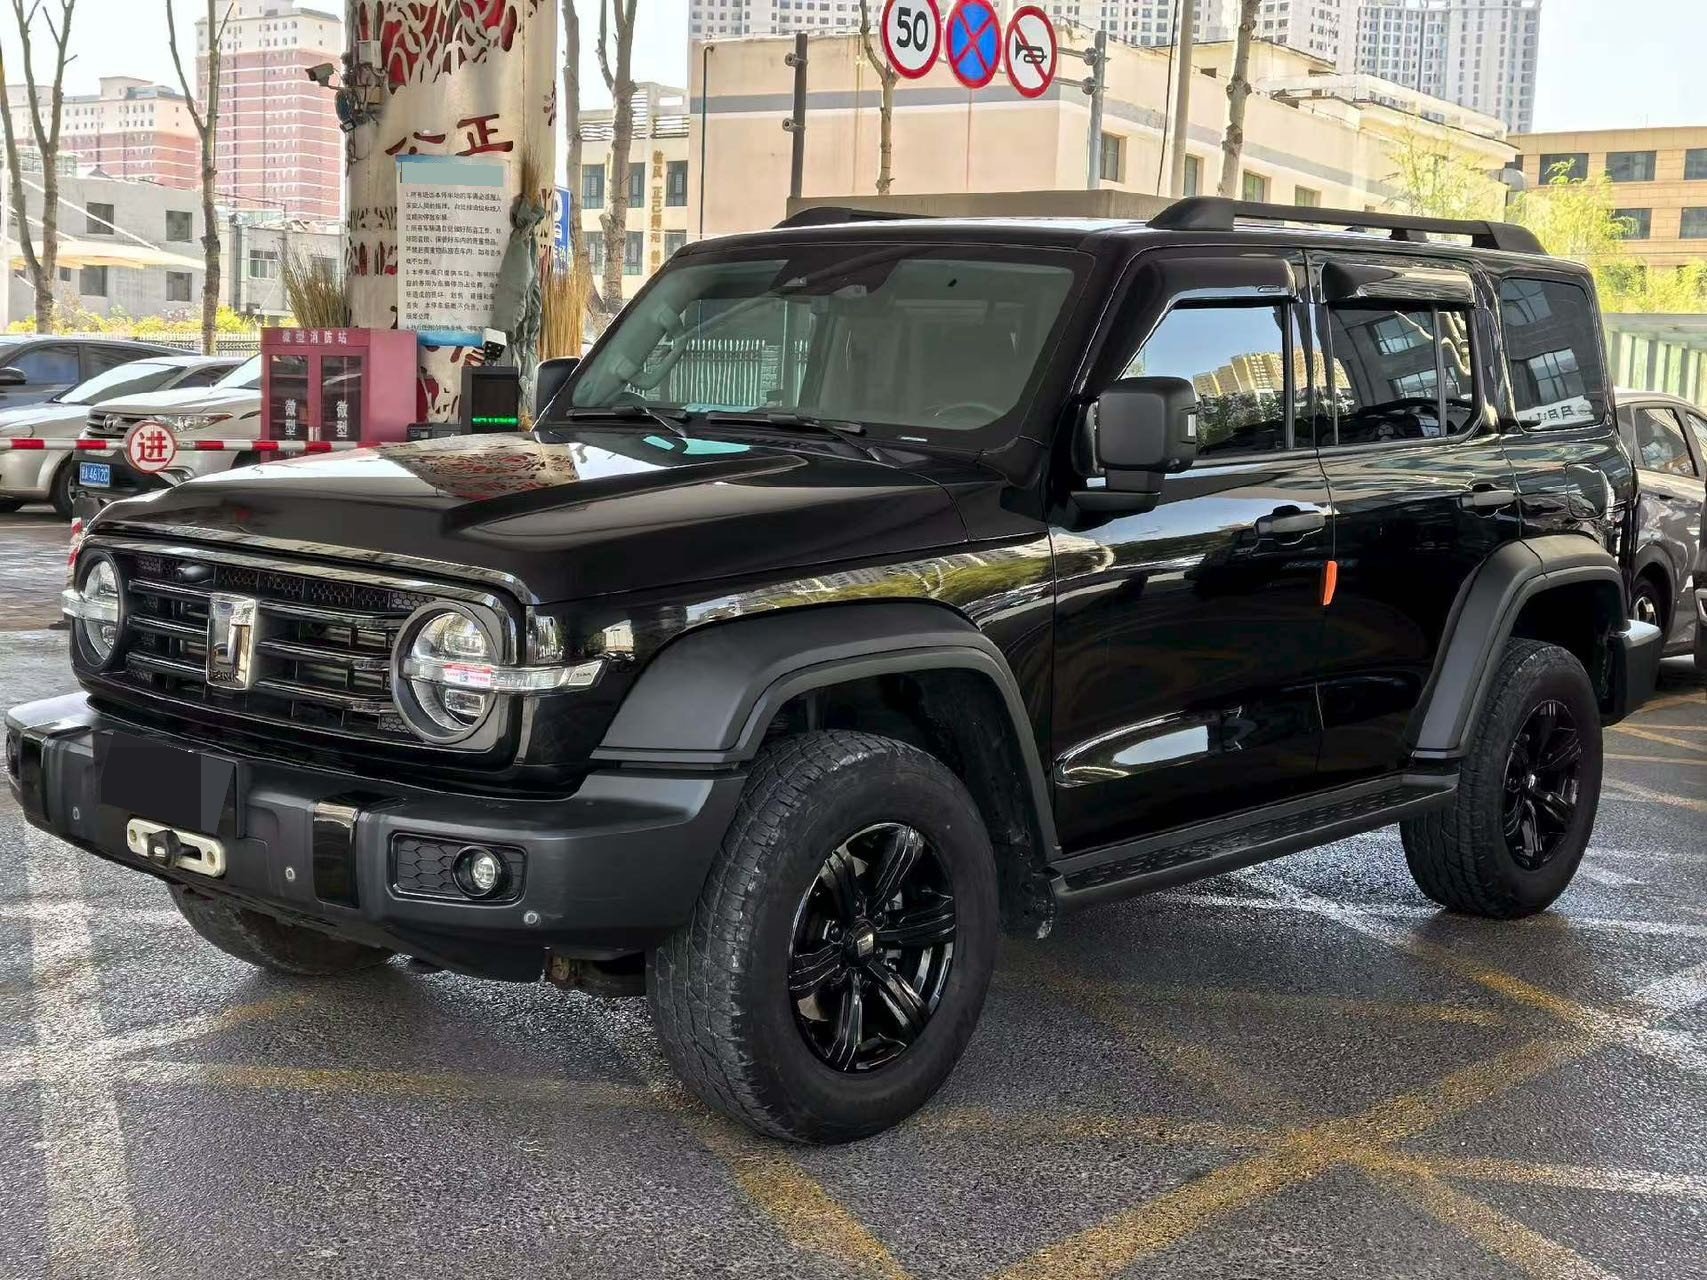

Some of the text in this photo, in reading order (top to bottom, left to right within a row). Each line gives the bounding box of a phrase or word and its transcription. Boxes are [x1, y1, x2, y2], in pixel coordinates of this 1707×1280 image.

[896, 6, 929, 53] 50
[282, 330, 347, 344] 微型消防站
[336, 399, 349, 438] 微型
[137, 430, 168, 463] 进
